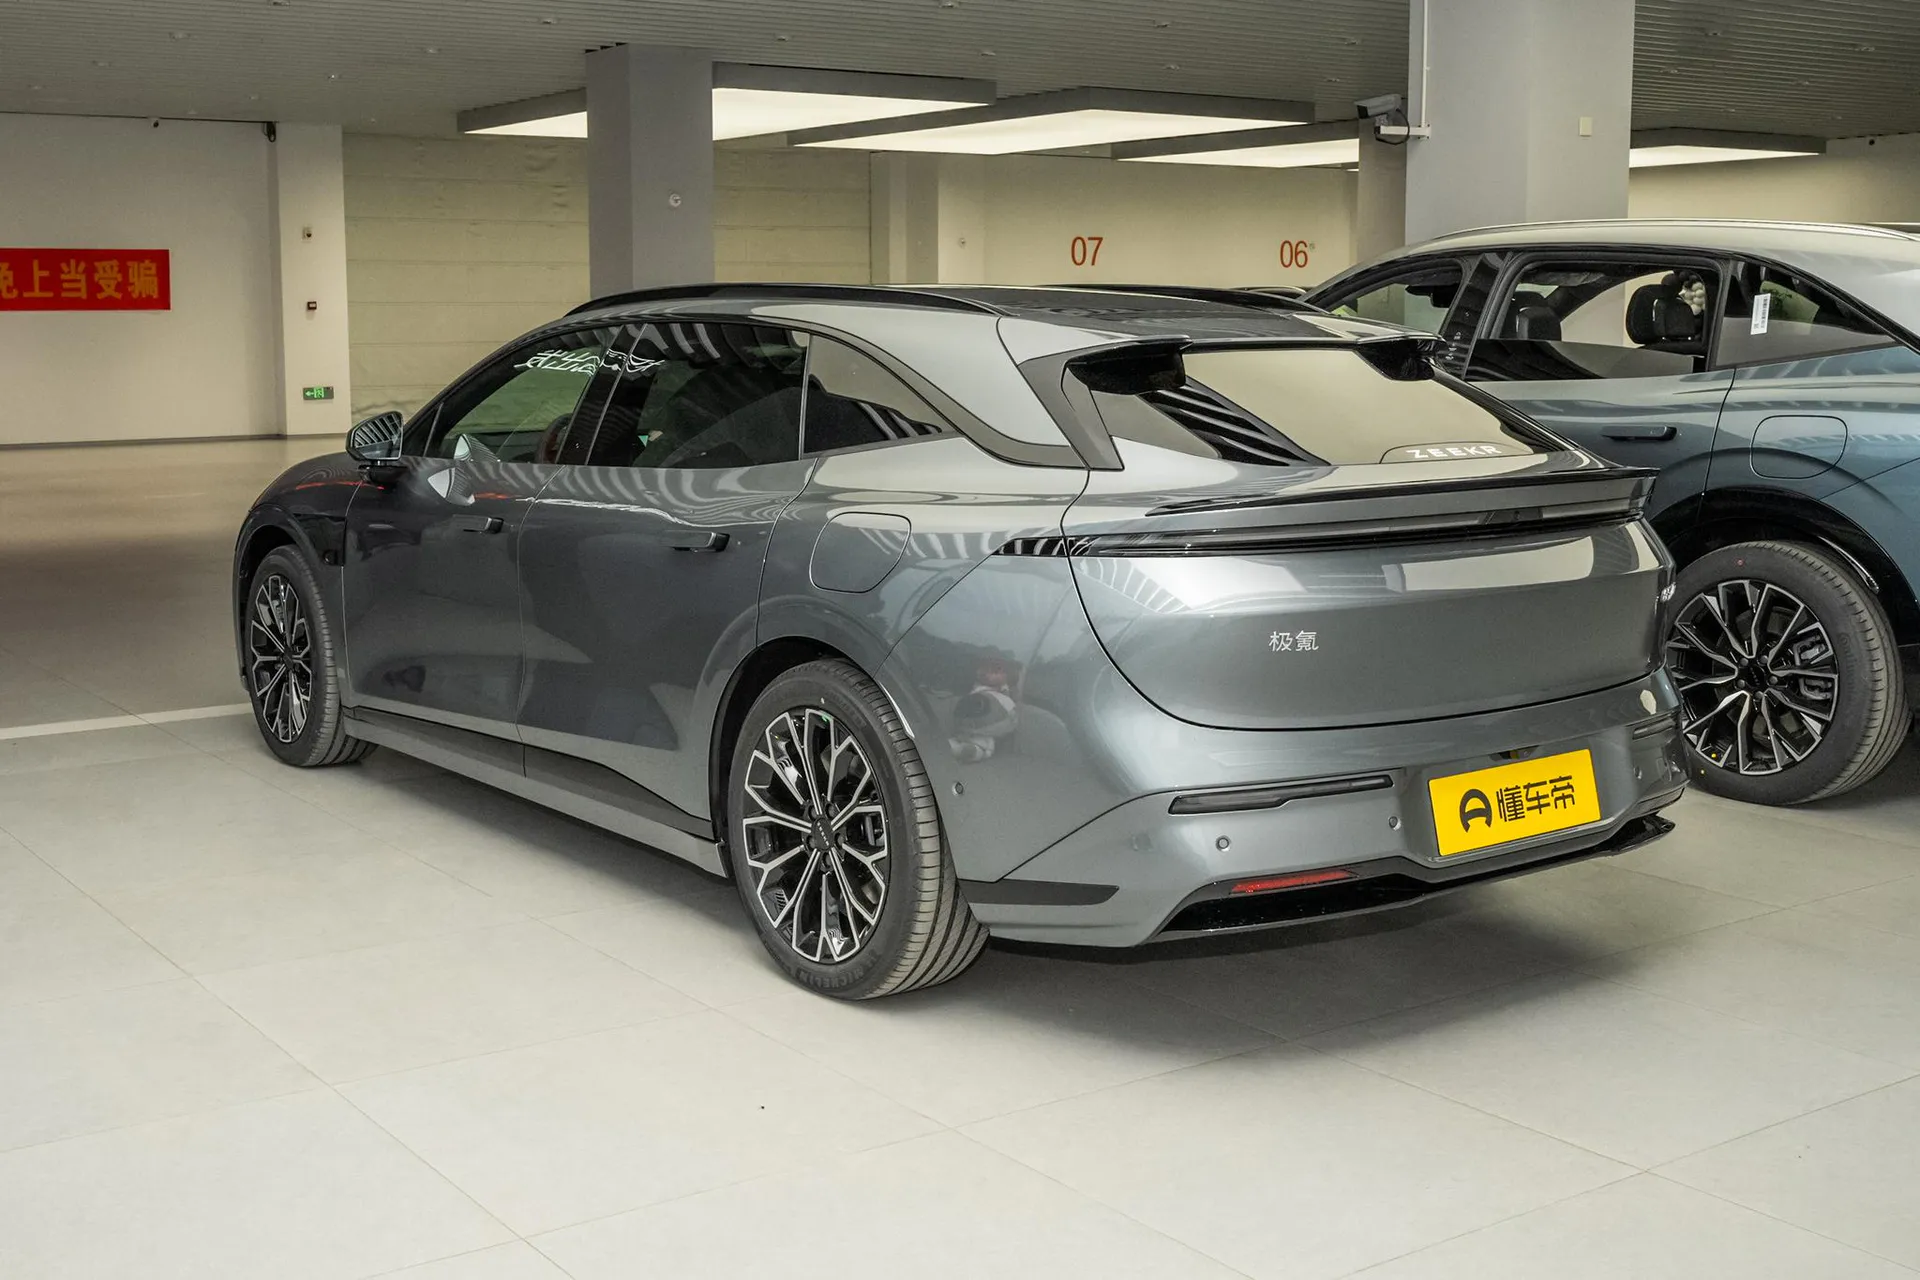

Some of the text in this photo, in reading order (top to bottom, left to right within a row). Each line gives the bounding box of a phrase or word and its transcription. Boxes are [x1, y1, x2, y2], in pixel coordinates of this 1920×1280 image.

[1071, 236, 1104, 266] 07
[1279, 240, 1308, 268] 06
[1406, 445, 1503, 459] ZEEKR
[1268, 630, 1320, 652] 极氪
[1496, 775, 1576, 823] 懂车帝
[799, 966, 864, 989] MICHELIN
